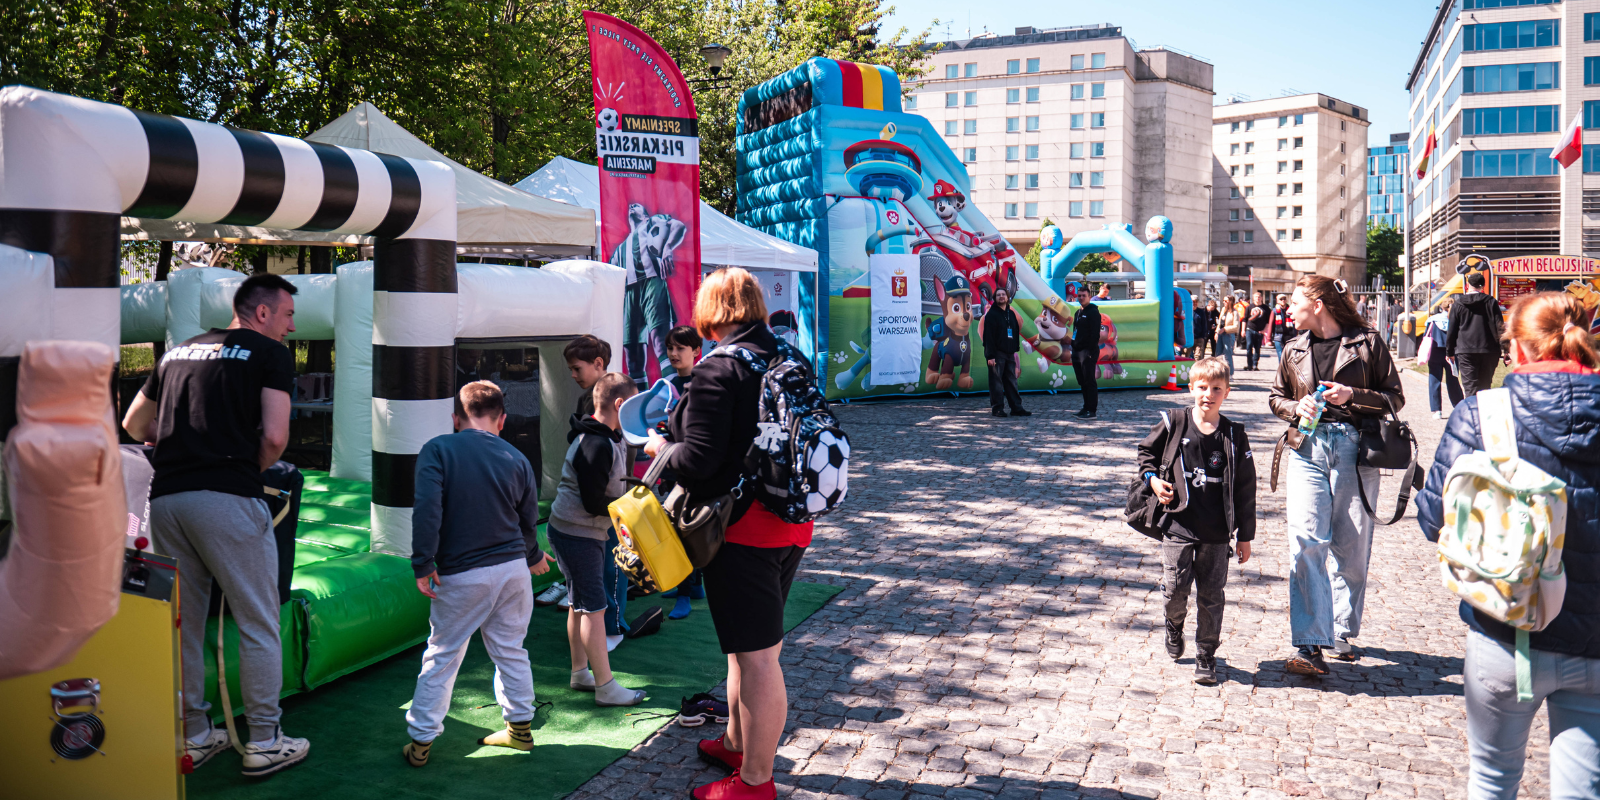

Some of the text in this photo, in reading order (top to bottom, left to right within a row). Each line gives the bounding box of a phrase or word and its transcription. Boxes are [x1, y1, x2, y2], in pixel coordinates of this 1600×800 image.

[1497, 257, 1594, 272] FRYTKI BELGIJSKIE
[878, 315, 918, 325] SPORTOWA
[878, 326, 918, 335] WARSZAWA
